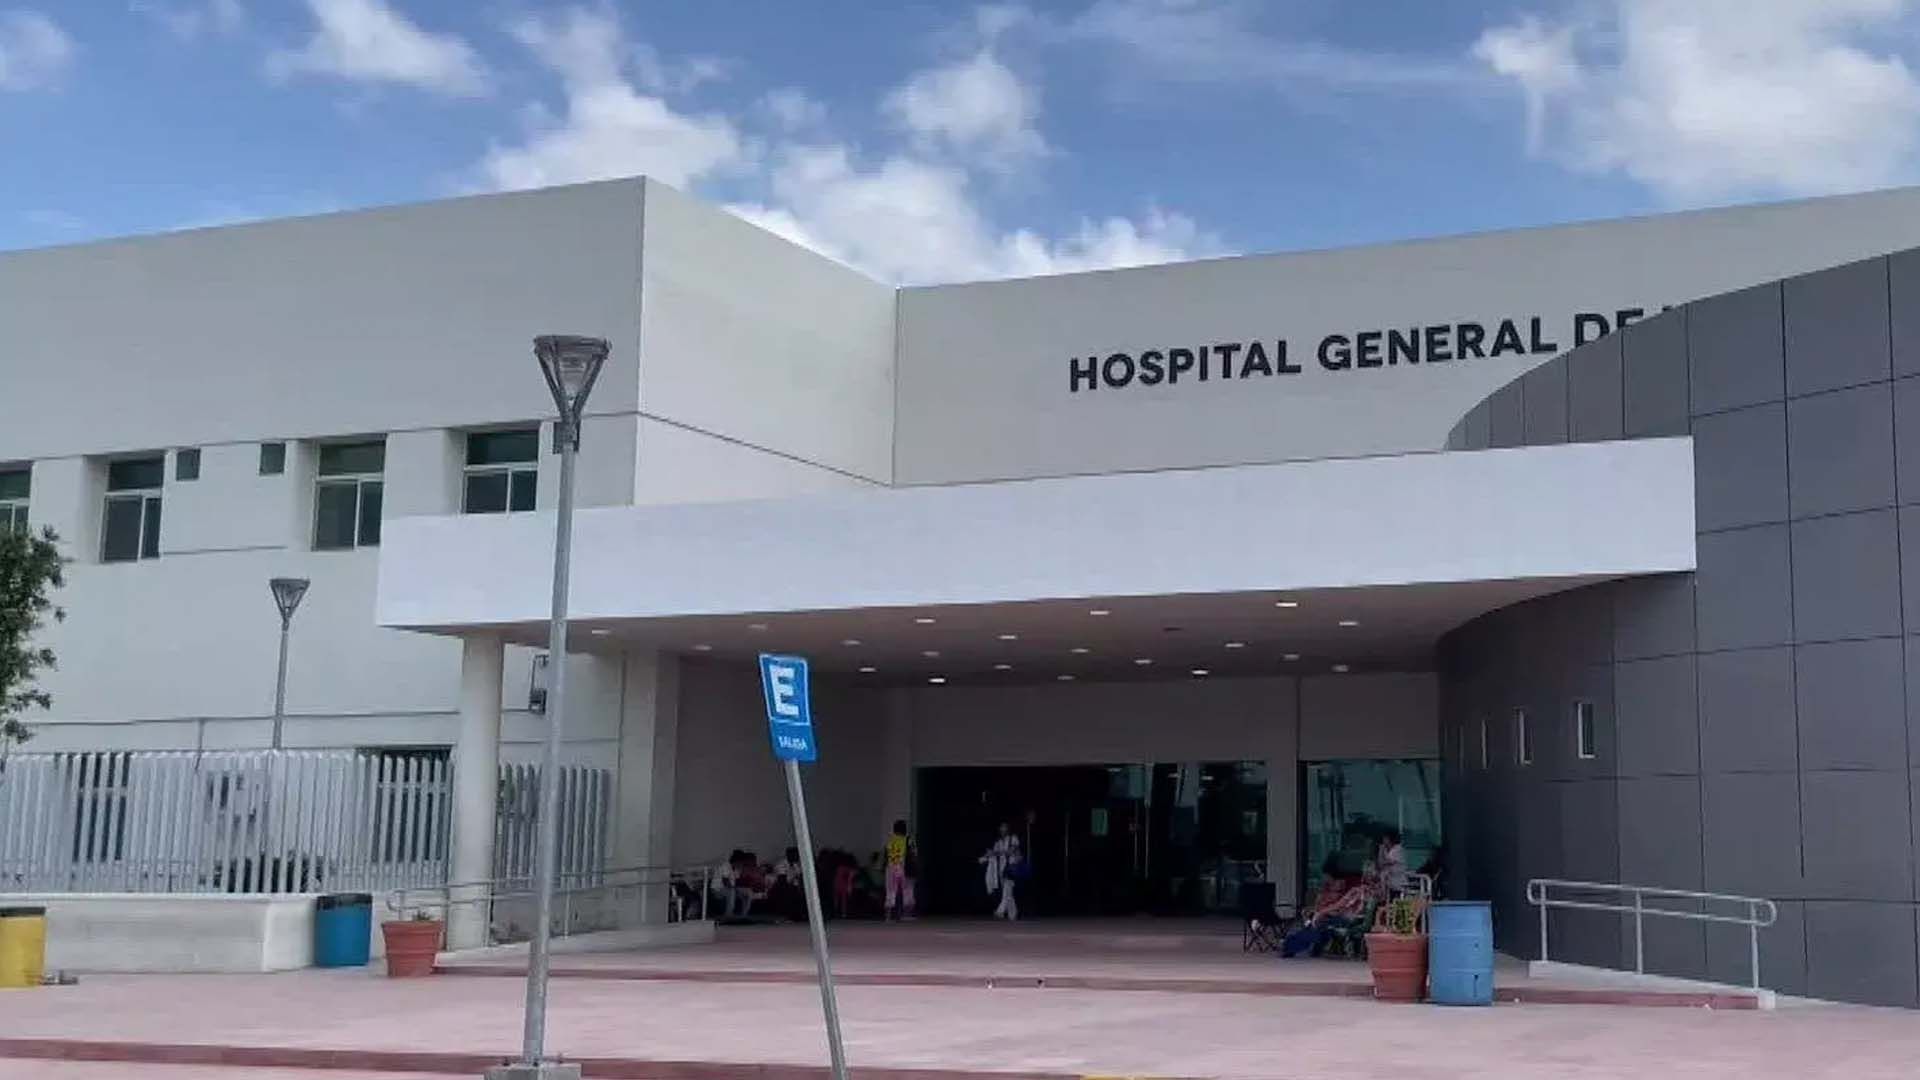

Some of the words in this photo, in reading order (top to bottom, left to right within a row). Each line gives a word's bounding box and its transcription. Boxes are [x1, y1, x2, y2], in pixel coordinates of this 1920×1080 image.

[1070, 340, 1302, 392] HOSPITAL
[1317, 317, 1557, 370] GENERAL
[769, 665, 799, 716] E
